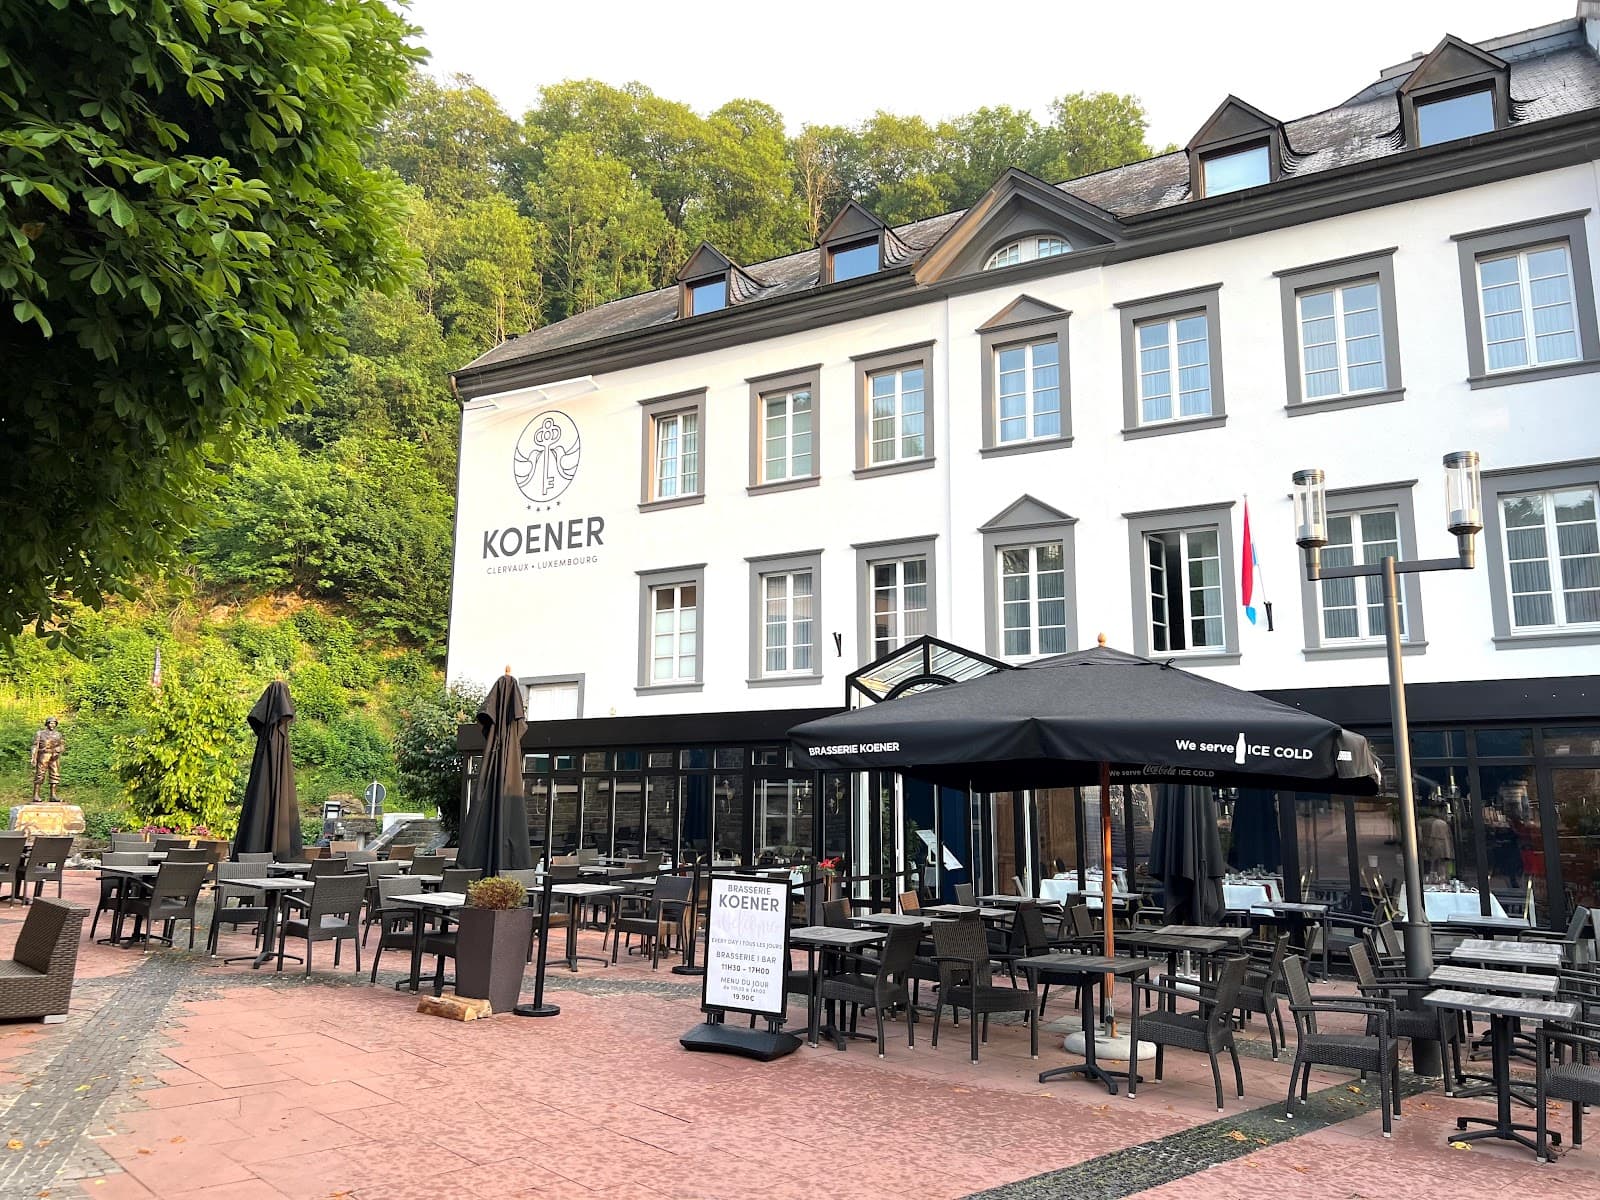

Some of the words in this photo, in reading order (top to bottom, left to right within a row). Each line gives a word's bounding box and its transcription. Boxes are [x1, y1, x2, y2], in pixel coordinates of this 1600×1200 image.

[482, 516, 604, 559] KOENER
[486, 564, 528, 574] CLERVAUX
[538, 556, 598, 569] LUXEMBOURG
[808, 744, 858, 756] BRASSERIE
[860, 742, 900, 753] KOENER
[1176, 740, 1196, 751] We
[1200, 742, 1234, 753] serve
[1247, 745, 1270, 756] ICE
[1274, 747, 1313, 760] COLD
[728, 884, 771, 894] BRASSERIE
[719, 894, 779, 912] KOENER
[716, 951, 756, 961] BRASSERIE
